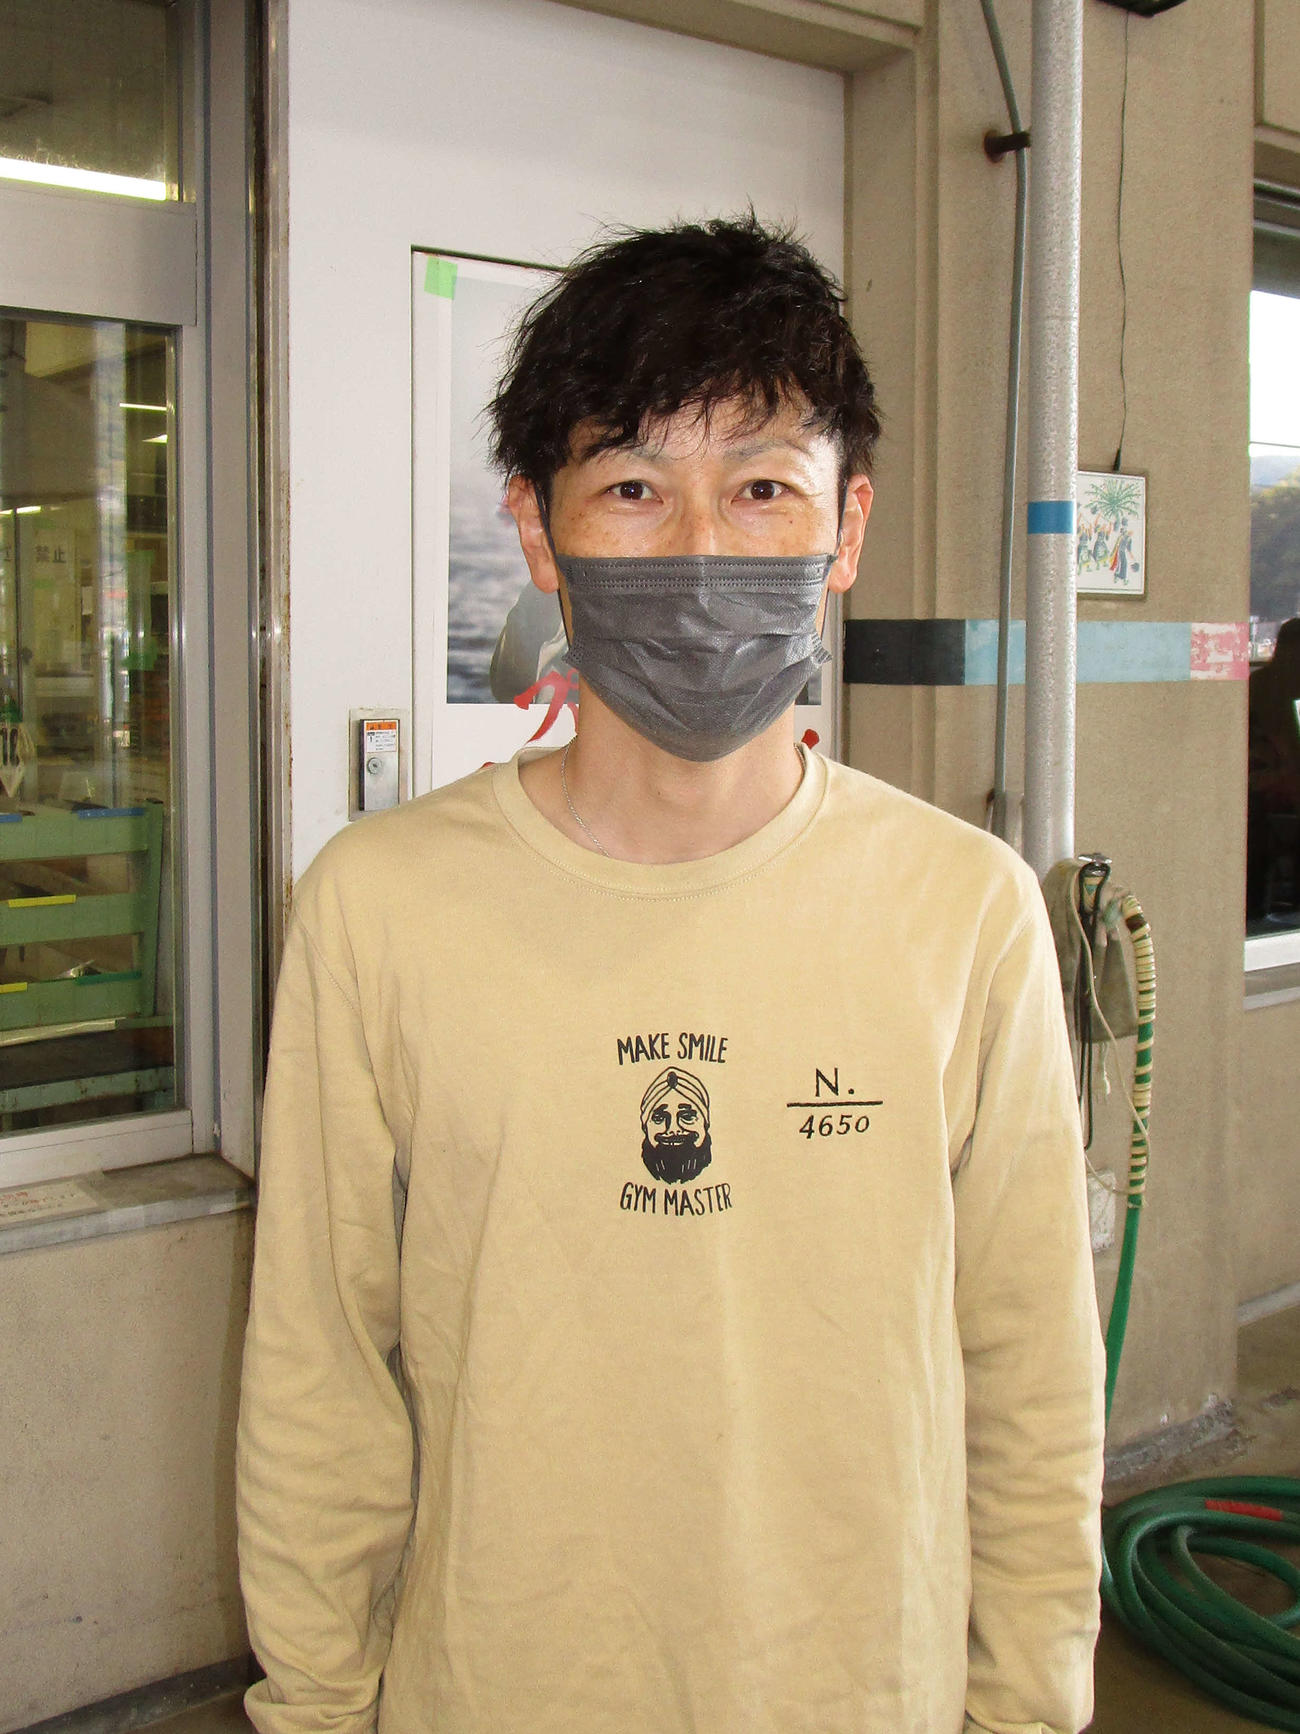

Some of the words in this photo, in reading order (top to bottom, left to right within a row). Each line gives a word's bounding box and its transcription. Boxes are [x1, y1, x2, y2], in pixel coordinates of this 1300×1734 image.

[617, 1033, 670, 1065] MAKE
[677, 1032, 729, 1064] SMILE
[815, 1067, 855, 1097] N.
[799, 1115, 870, 1139] 4650
[619, 1181, 657, 1214] GYM
[664, 1182, 733, 1217] MASTER
